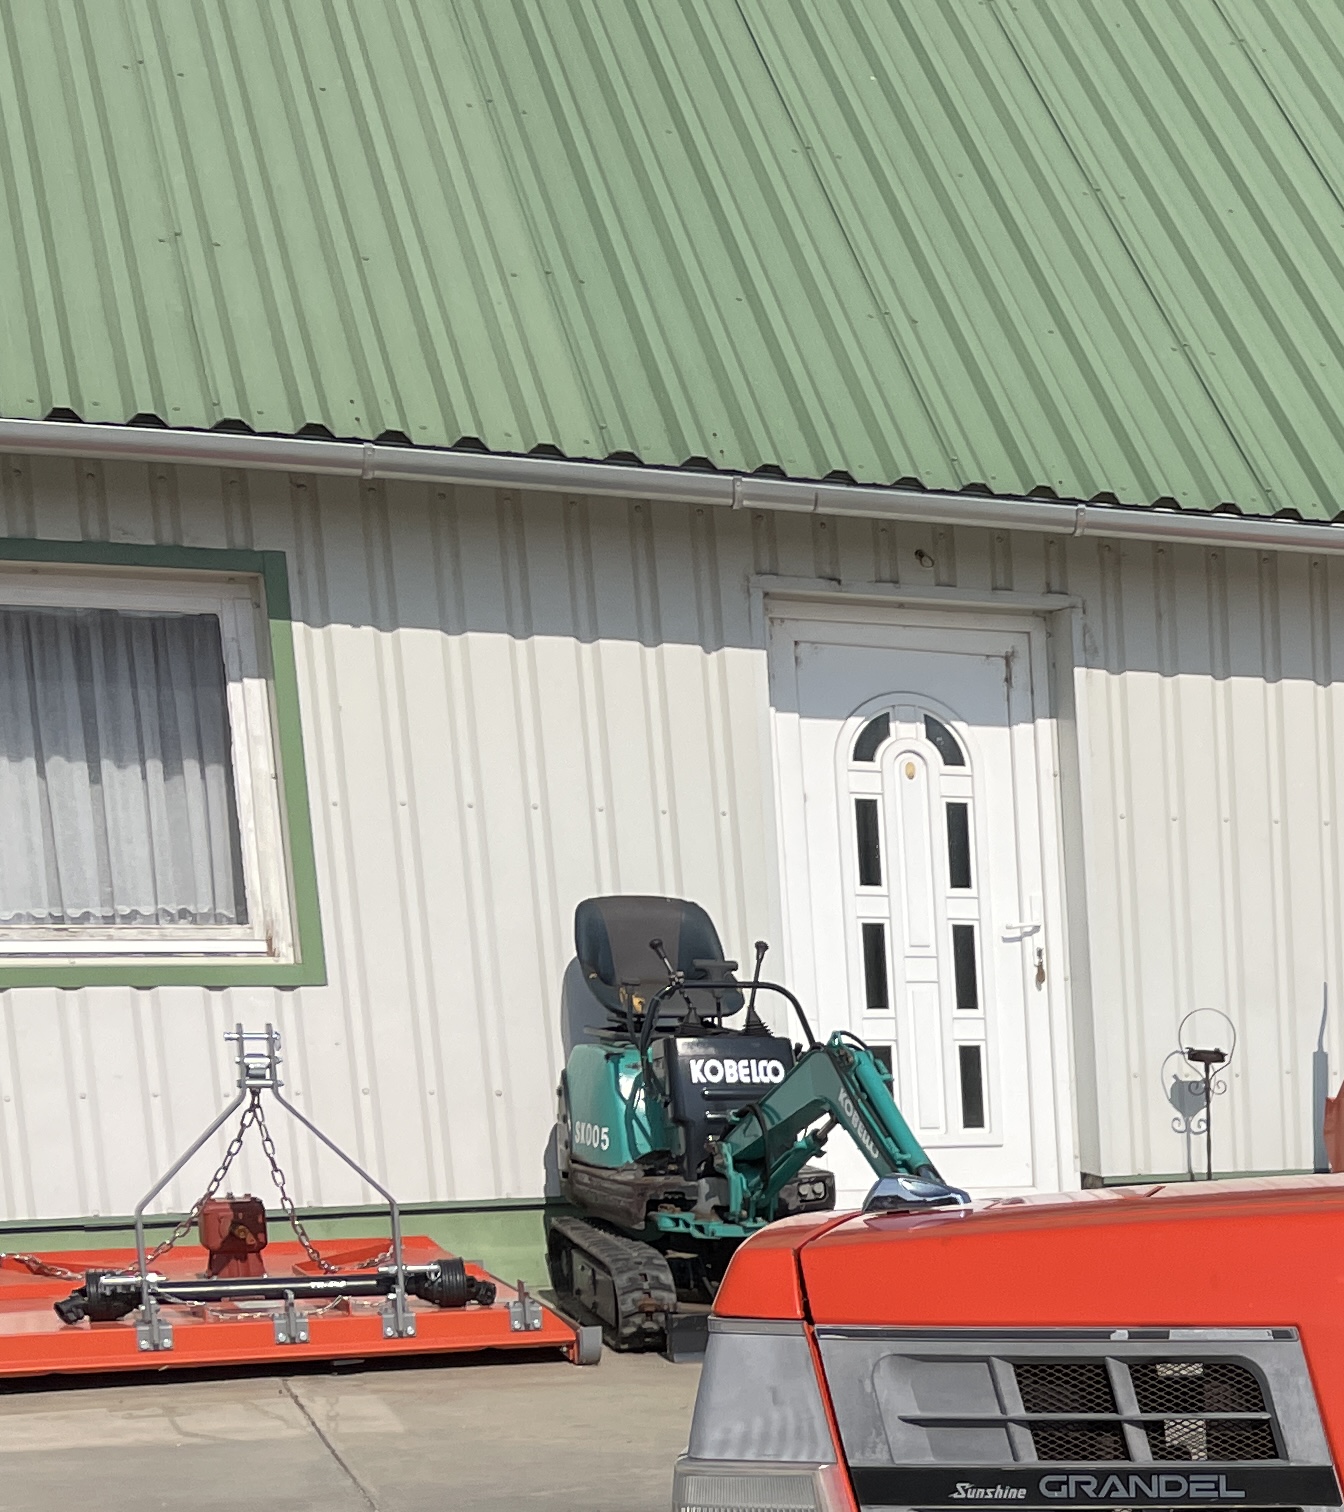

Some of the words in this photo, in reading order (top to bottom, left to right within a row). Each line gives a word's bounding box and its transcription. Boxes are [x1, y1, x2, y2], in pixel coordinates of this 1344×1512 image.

[690, 1059, 785, 1084] KOBELCO
[574, 1120, 610, 1150] SK005
[838, 1088, 879, 1158] KOBELCO
[948, 1482, 1027, 1499] Sunshine
[1039, 1475, 1246, 1498] GRANDEL
